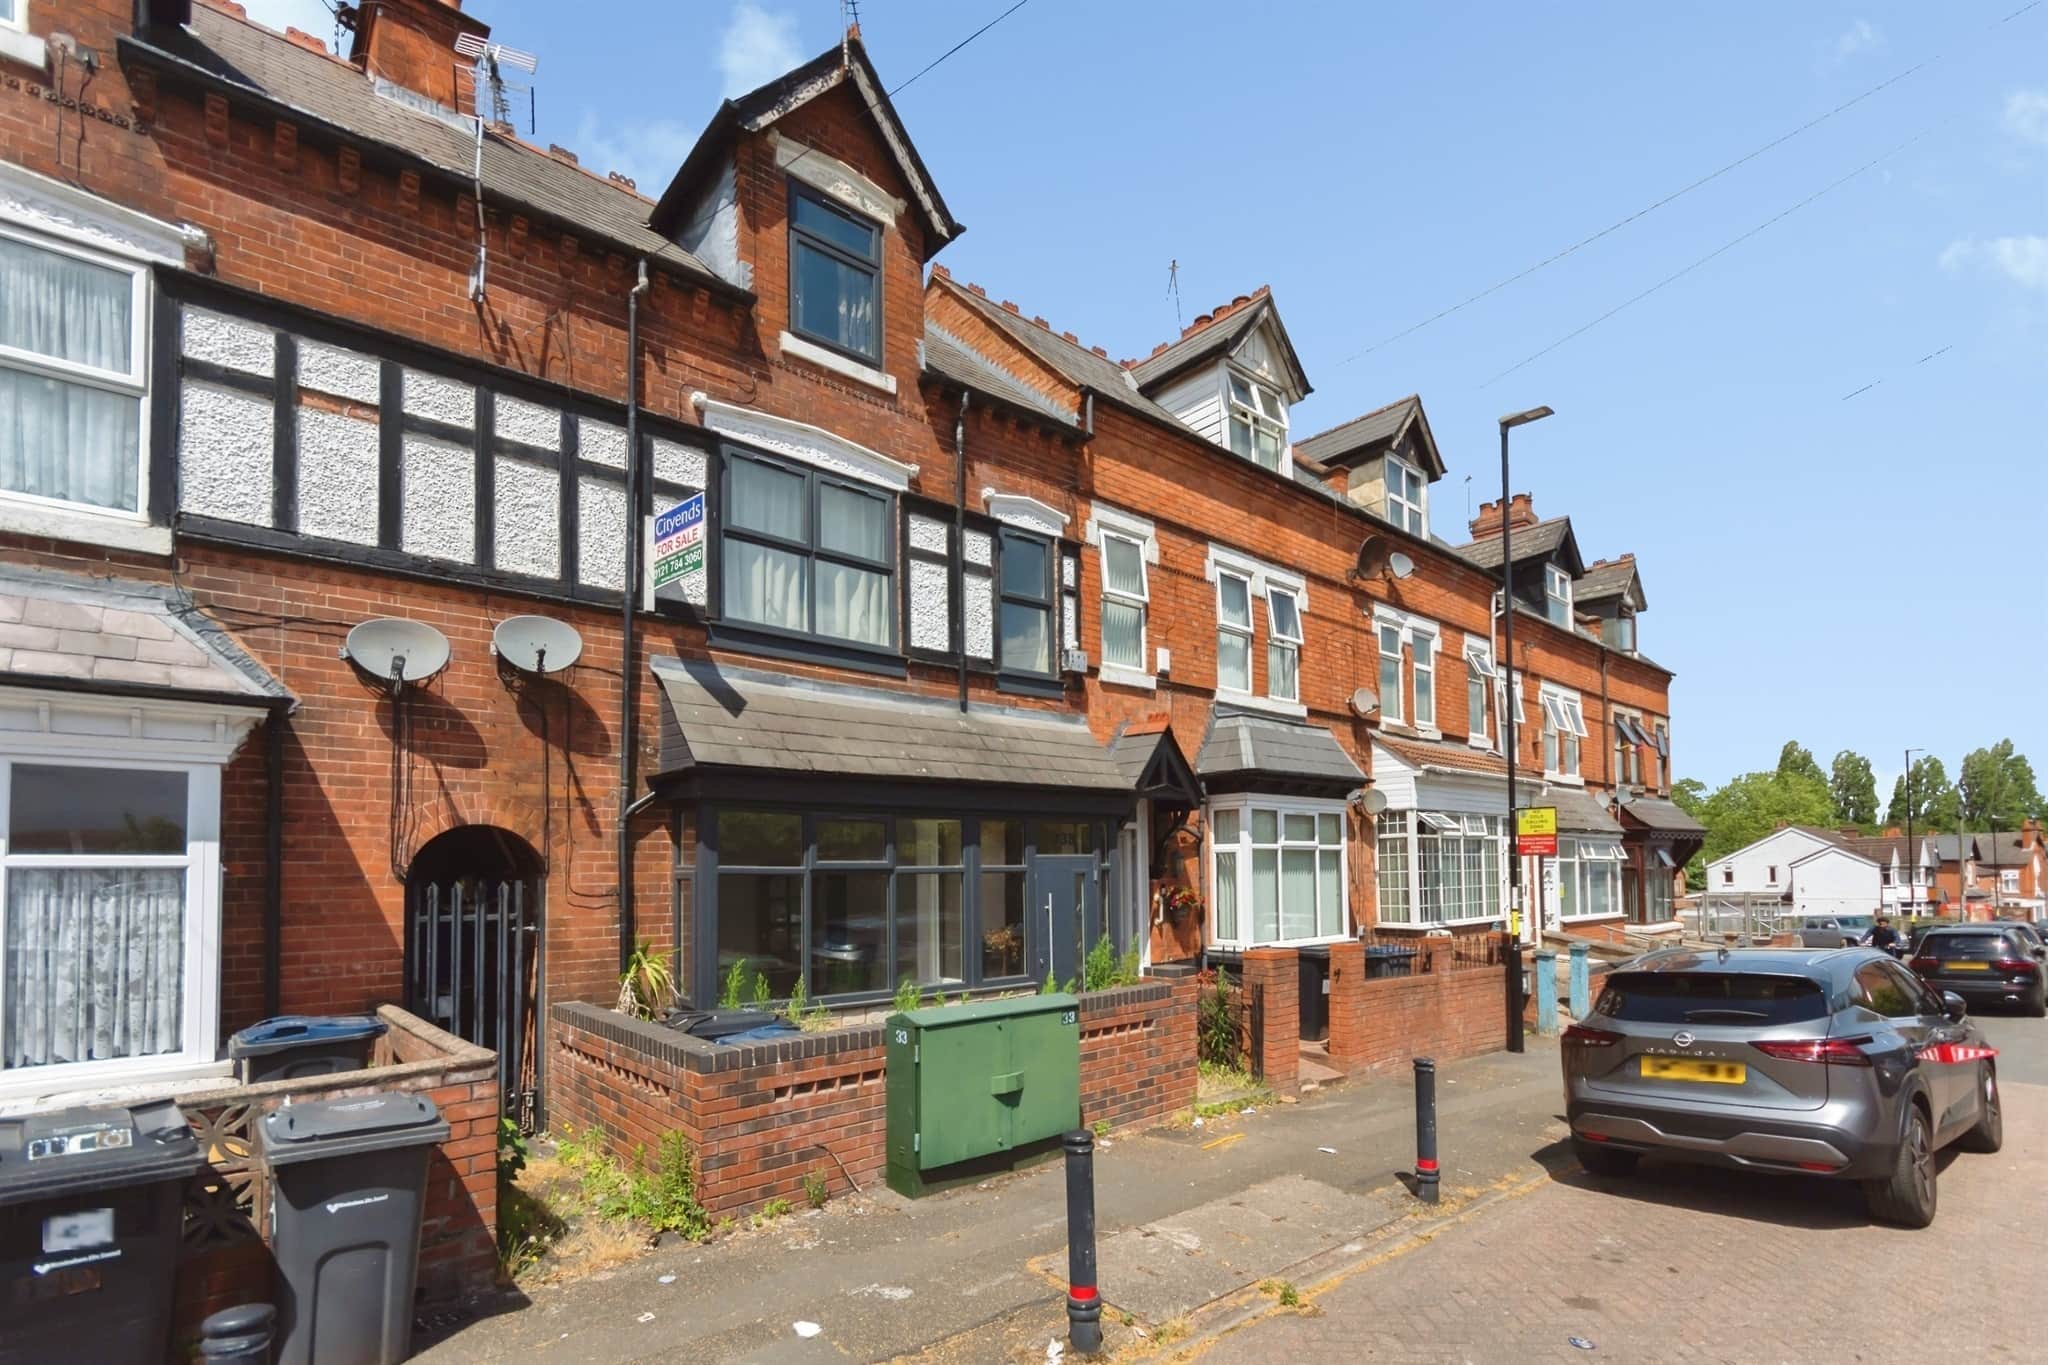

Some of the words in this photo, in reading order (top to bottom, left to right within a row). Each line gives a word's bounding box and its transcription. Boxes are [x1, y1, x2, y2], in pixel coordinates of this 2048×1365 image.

[656, 502, 701, 536] Cityends
[657, 539, 674, 558] FOR
[675, 527, 699, 549] SALE
[1062, 1011, 1075, 1024] 33
[895, 1029, 908, 1045] 33
